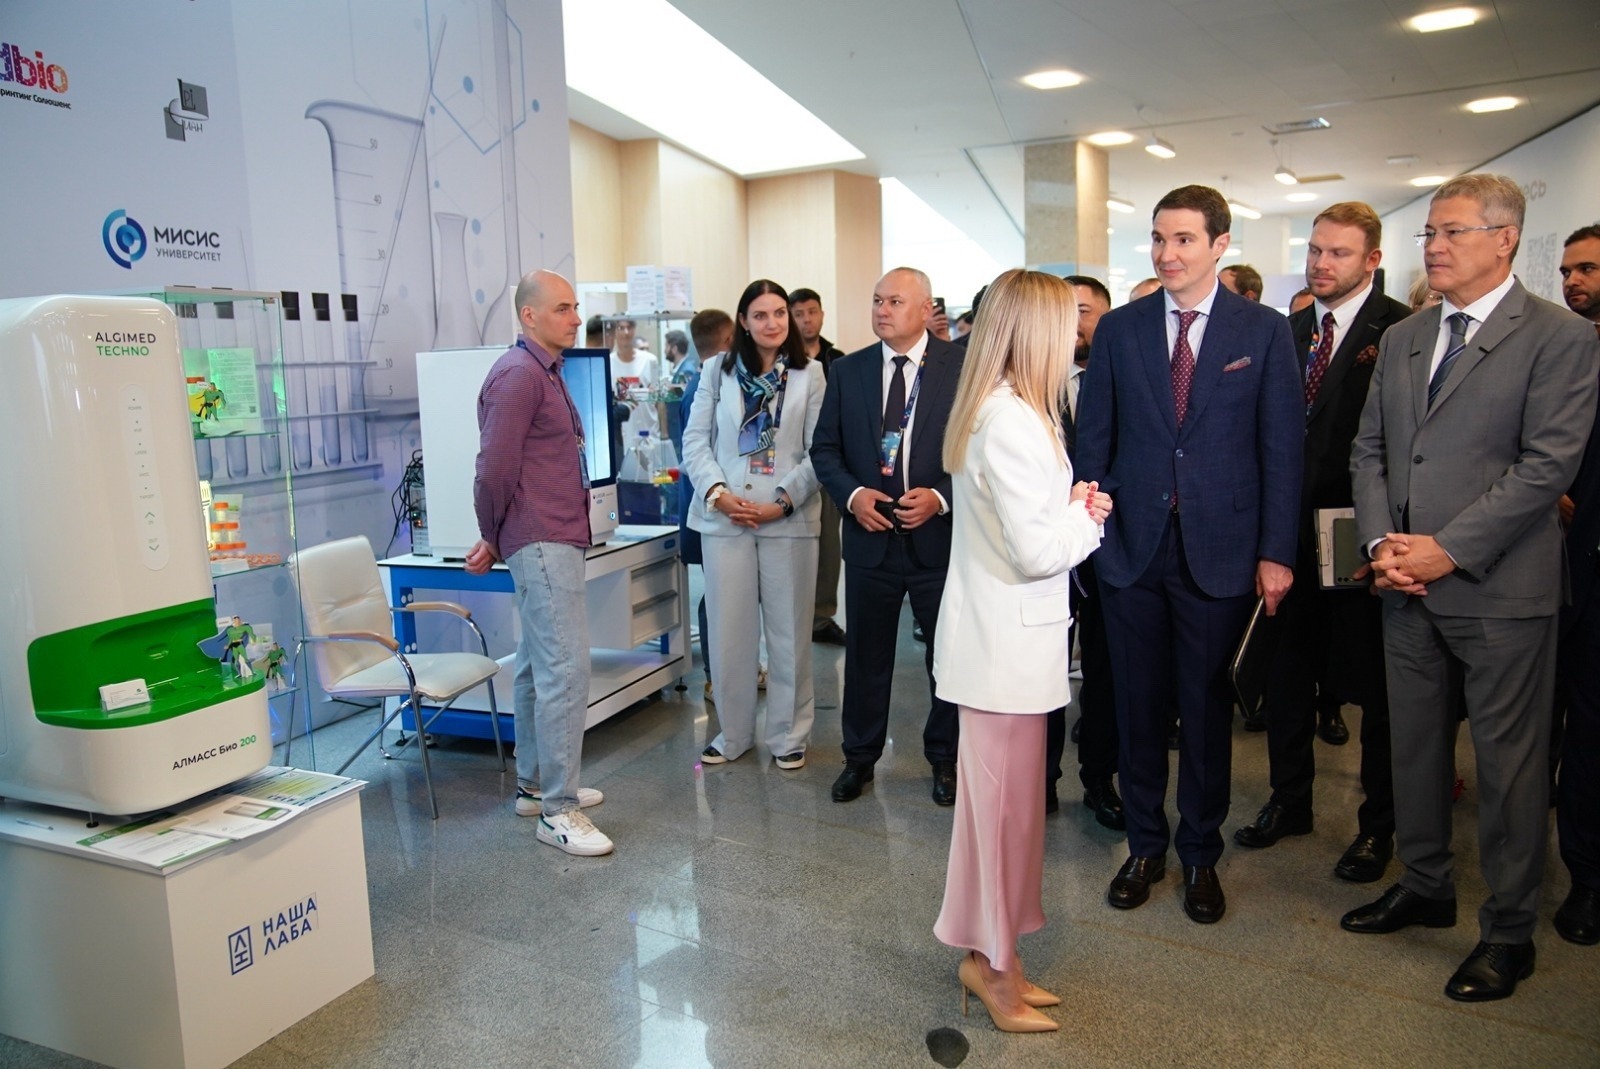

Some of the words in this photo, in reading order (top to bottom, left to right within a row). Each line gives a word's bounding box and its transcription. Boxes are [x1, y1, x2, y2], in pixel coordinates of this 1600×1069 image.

[33, 94, 72, 110] Солюшенс
[369, 138, 378, 150] 50
[154, 226, 220, 248] МИСИС
[156, 248, 222, 261] УНИВЕРСИТЕТ
[381, 304, 389, 315] 20
[95, 332, 157, 344] ALGIMED
[96, 345, 150, 356] TECHNO
[386, 358, 393, 368] 10
[388, 385, 393, 396] 5
[172, 748, 217, 771] АЛМАСС
[219, 742, 238, 755] Био
[239, 734, 257, 747] 200
[262, 897, 317, 937] НАША
[263, 918, 312, 956] ЛАБА
